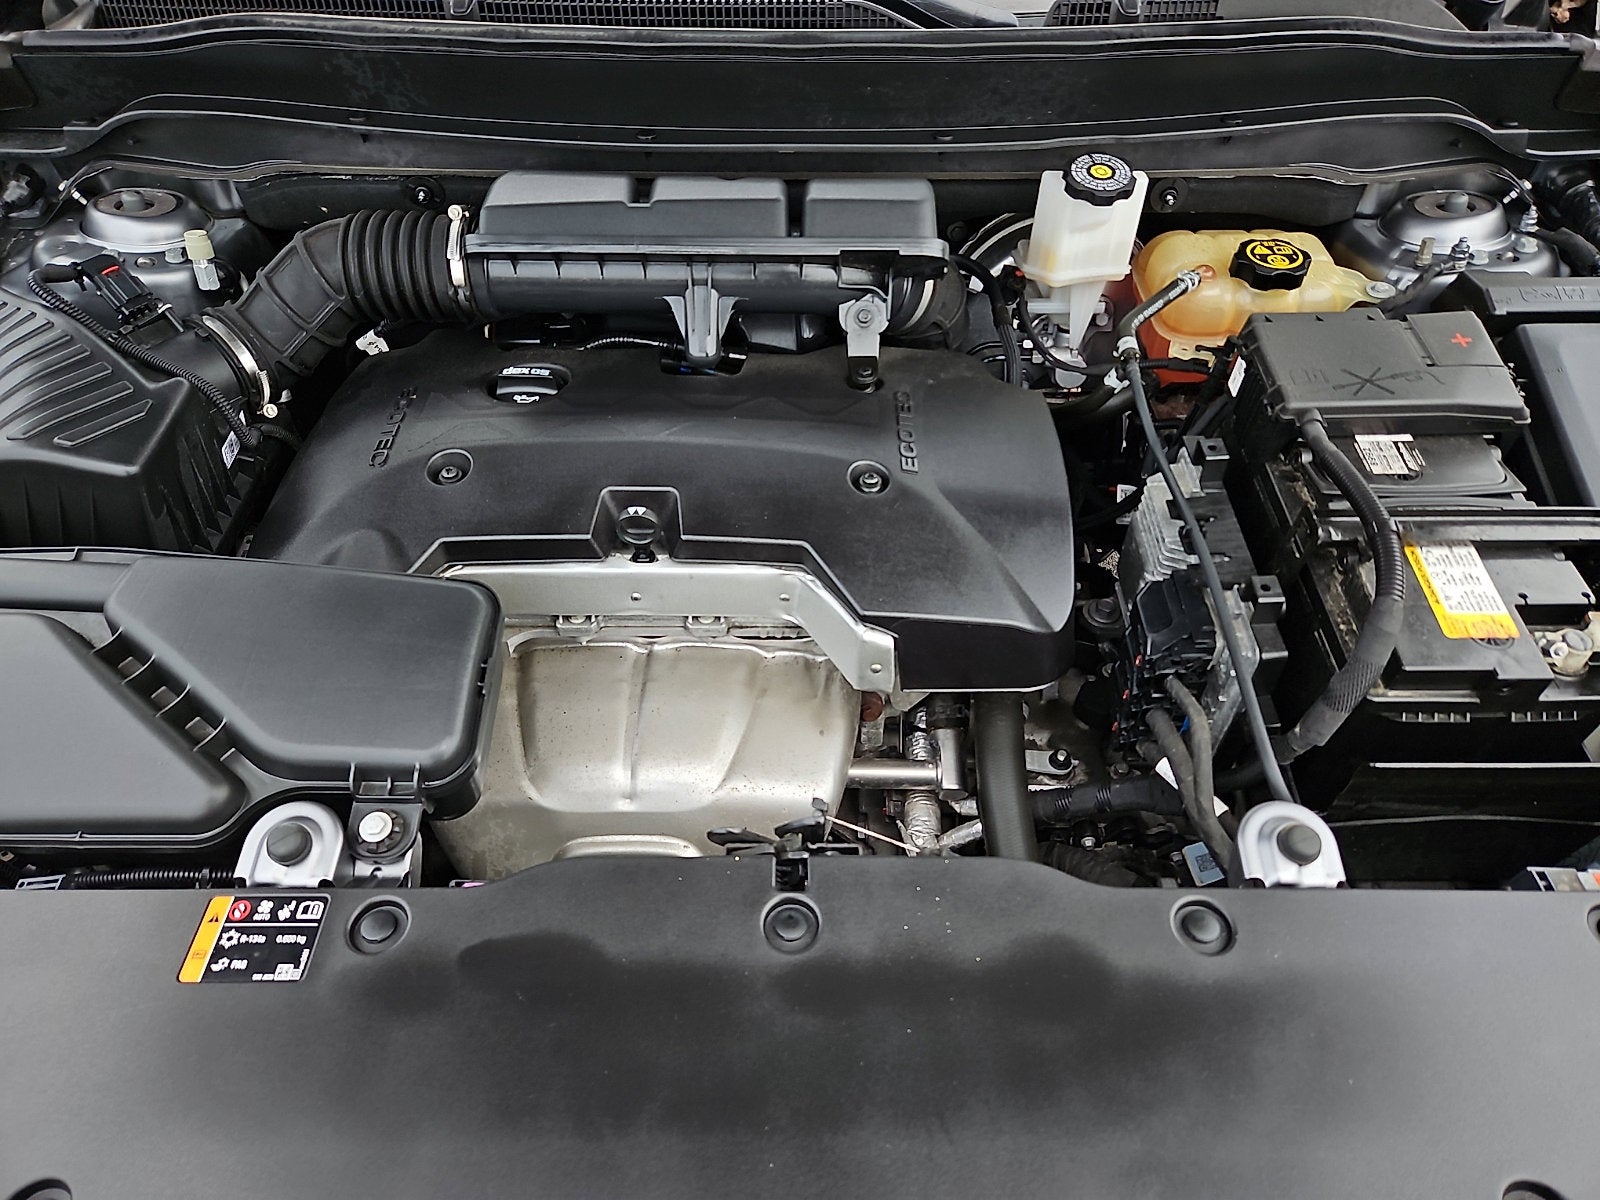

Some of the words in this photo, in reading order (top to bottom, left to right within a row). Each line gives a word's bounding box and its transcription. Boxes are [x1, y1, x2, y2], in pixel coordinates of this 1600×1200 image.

[368, 386, 418, 468] ECOTEC
[894, 391, 919, 474] ECOTEC
[252, 912, 272, 921] AUTO
